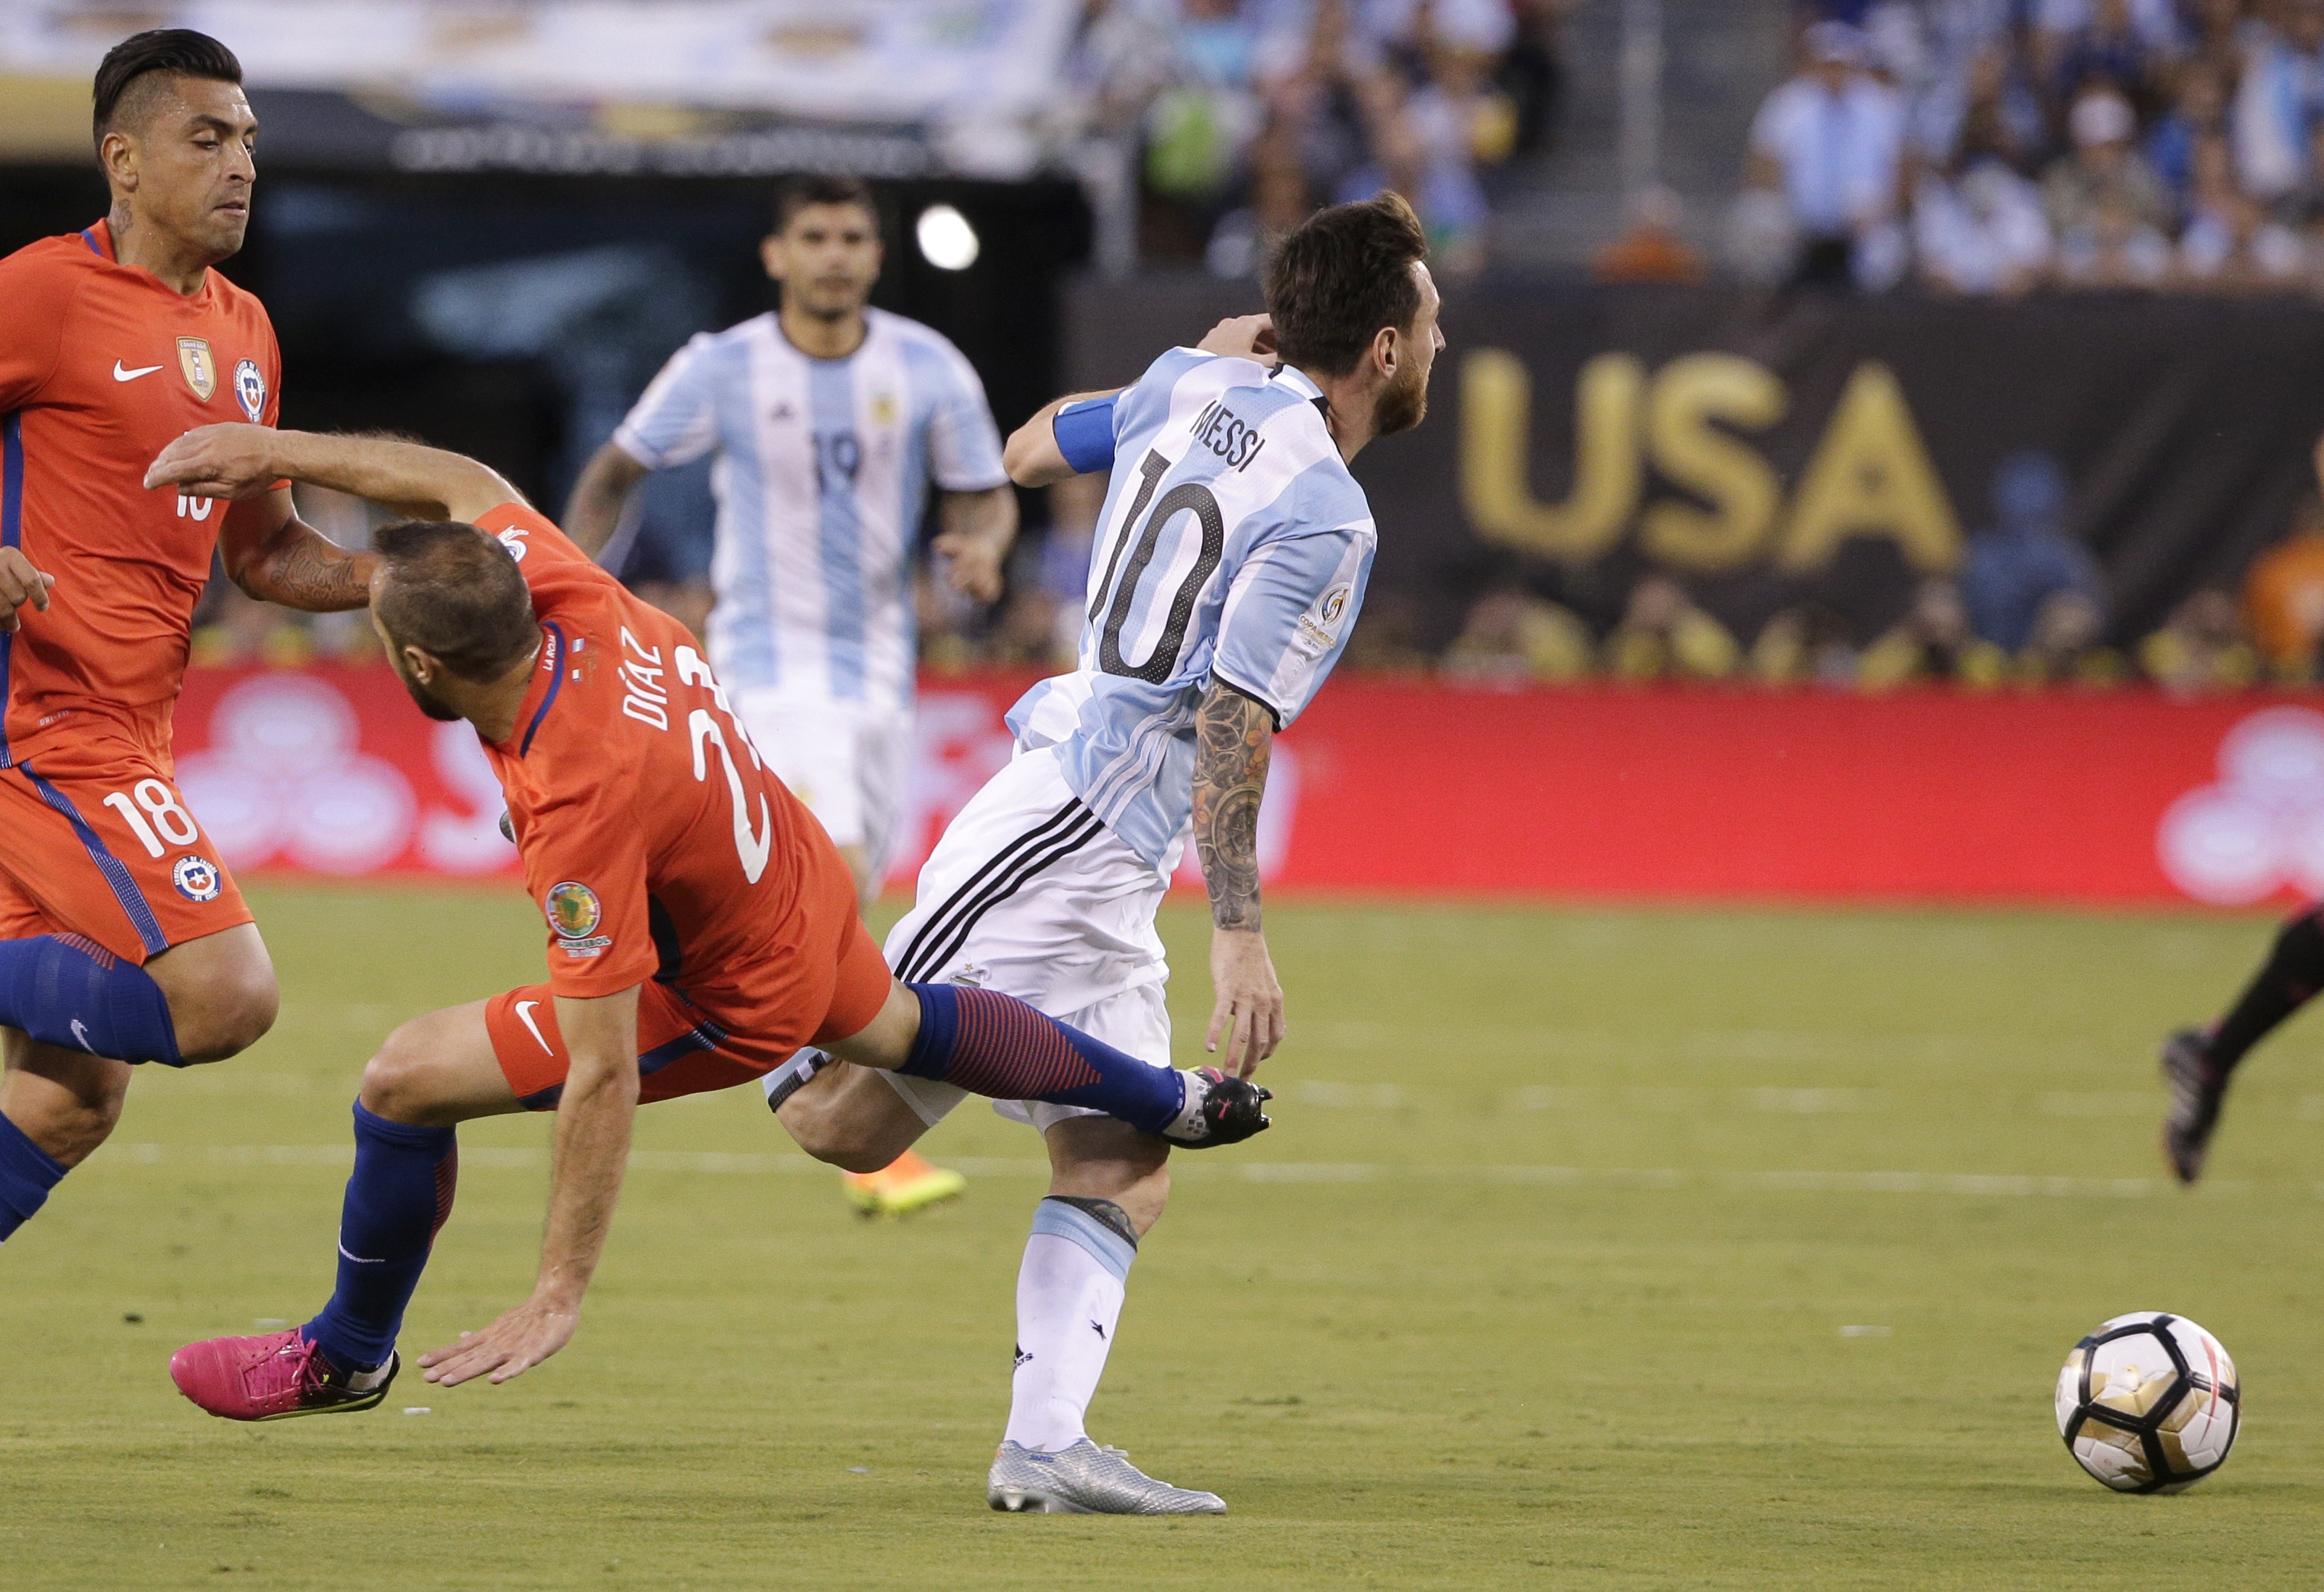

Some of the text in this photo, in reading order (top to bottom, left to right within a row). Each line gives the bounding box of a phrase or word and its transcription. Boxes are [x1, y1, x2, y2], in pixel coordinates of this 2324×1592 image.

[811, 430, 863, 496] 19
[1190, 399, 1266, 473] MESSI
[1456, 347, 1967, 573] USA
[1090, 449, 1224, 684] 10
[542, 659, 555, 671] LA
[618, 626, 668, 731] DÍAZ
[103, 778, 199, 858] 18
